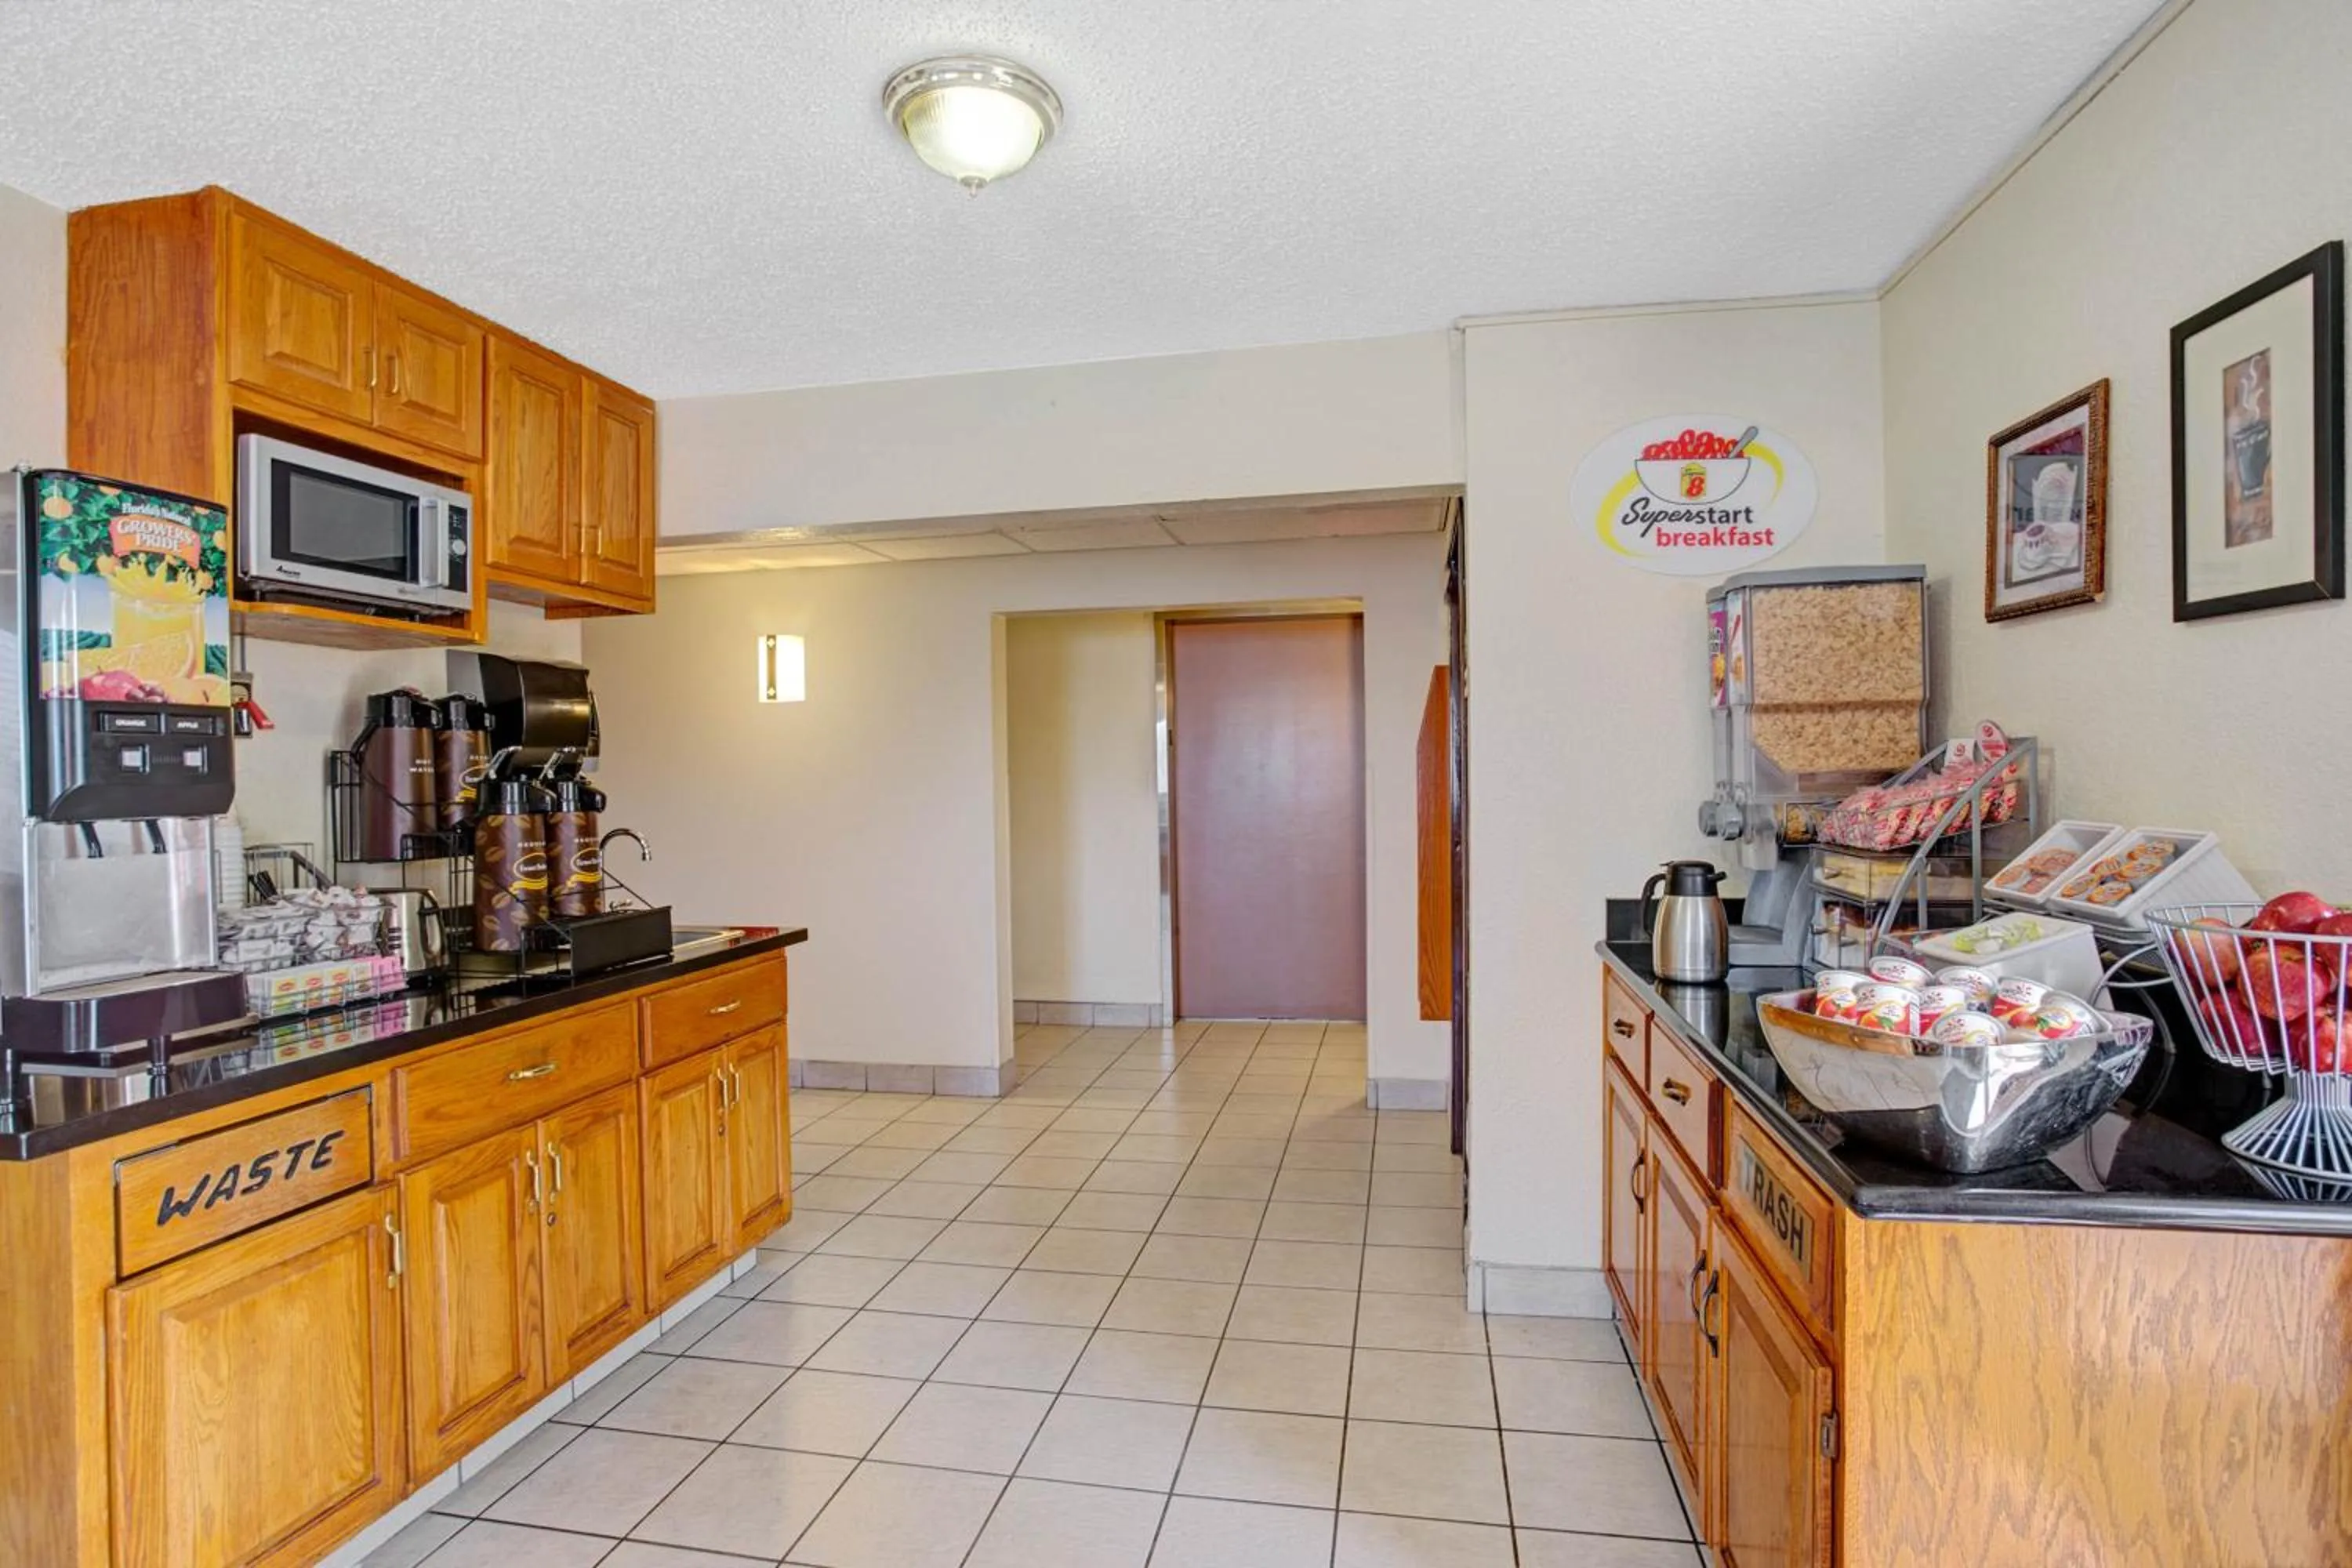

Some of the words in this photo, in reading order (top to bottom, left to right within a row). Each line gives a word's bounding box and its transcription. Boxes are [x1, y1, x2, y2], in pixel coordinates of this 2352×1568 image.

[1621, 497, 1754, 538] Superstart
[1656, 527, 1775, 547] breakfast
[156, 1130, 345, 1227] WASTE
[1743, 1146, 1805, 1261] TRASH
